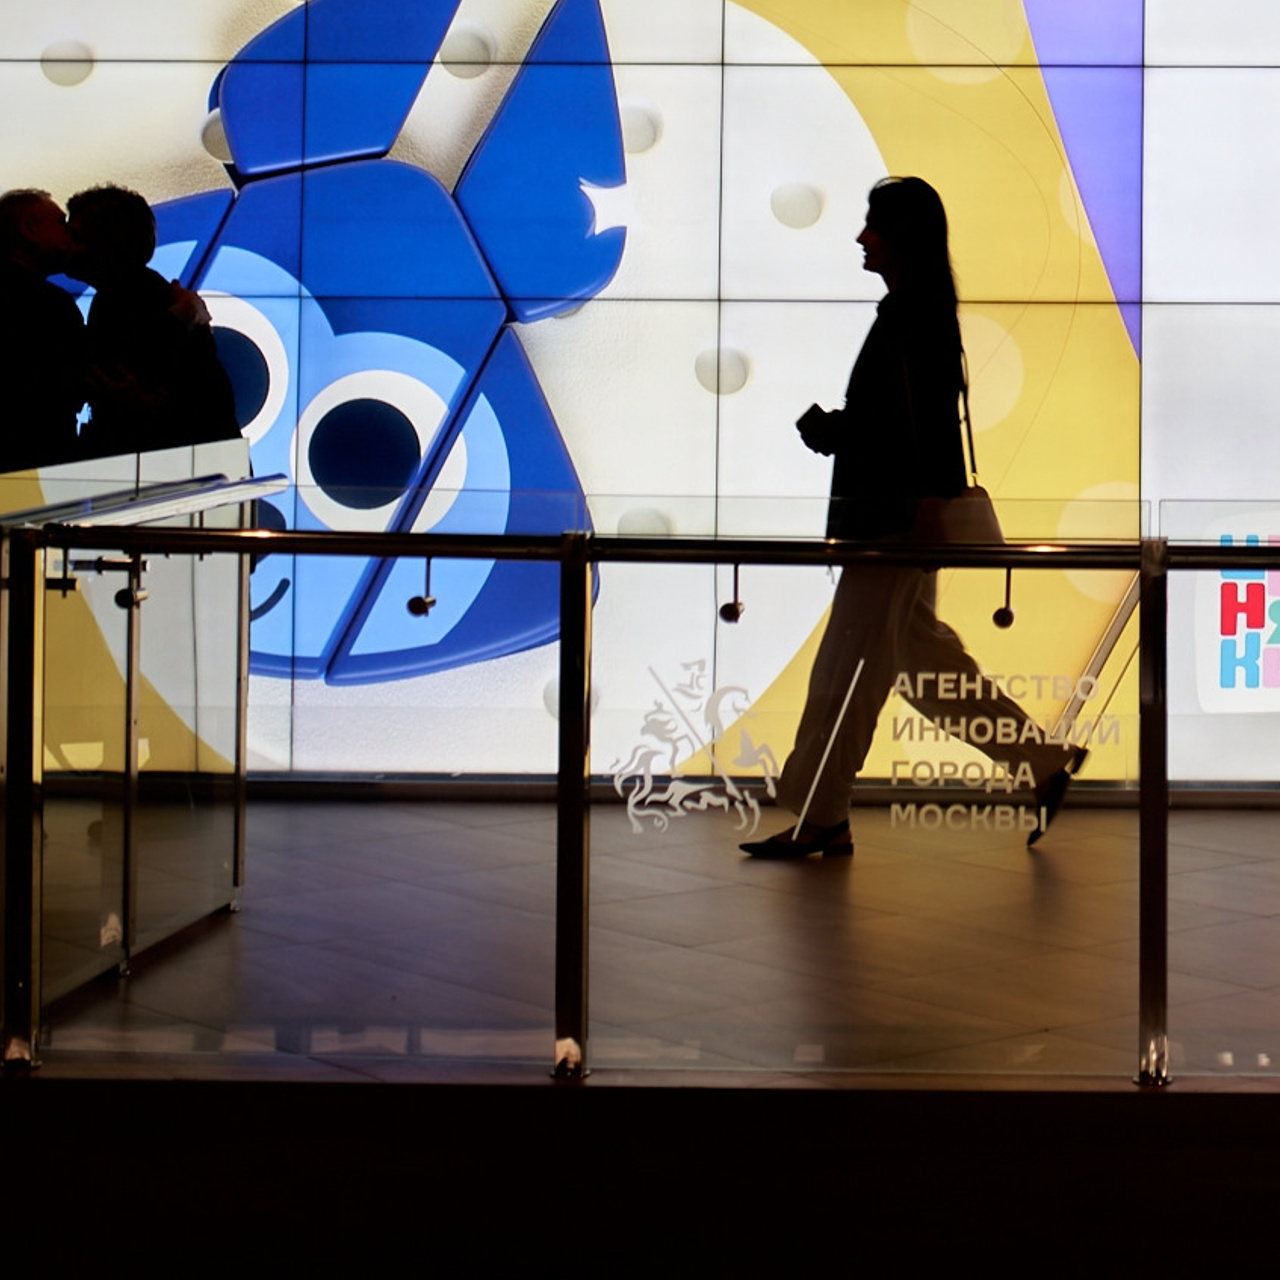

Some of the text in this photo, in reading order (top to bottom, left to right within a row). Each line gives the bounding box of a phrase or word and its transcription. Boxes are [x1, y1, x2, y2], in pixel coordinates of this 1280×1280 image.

[892, 671, 1100, 701] АГЕНТСТВО
[891, 713, 1121, 751] ИННОВАЦИЙ
[891, 760, 1037, 794] ГОРОДА
[890, 802, 1048, 832] МОСКВЫ
